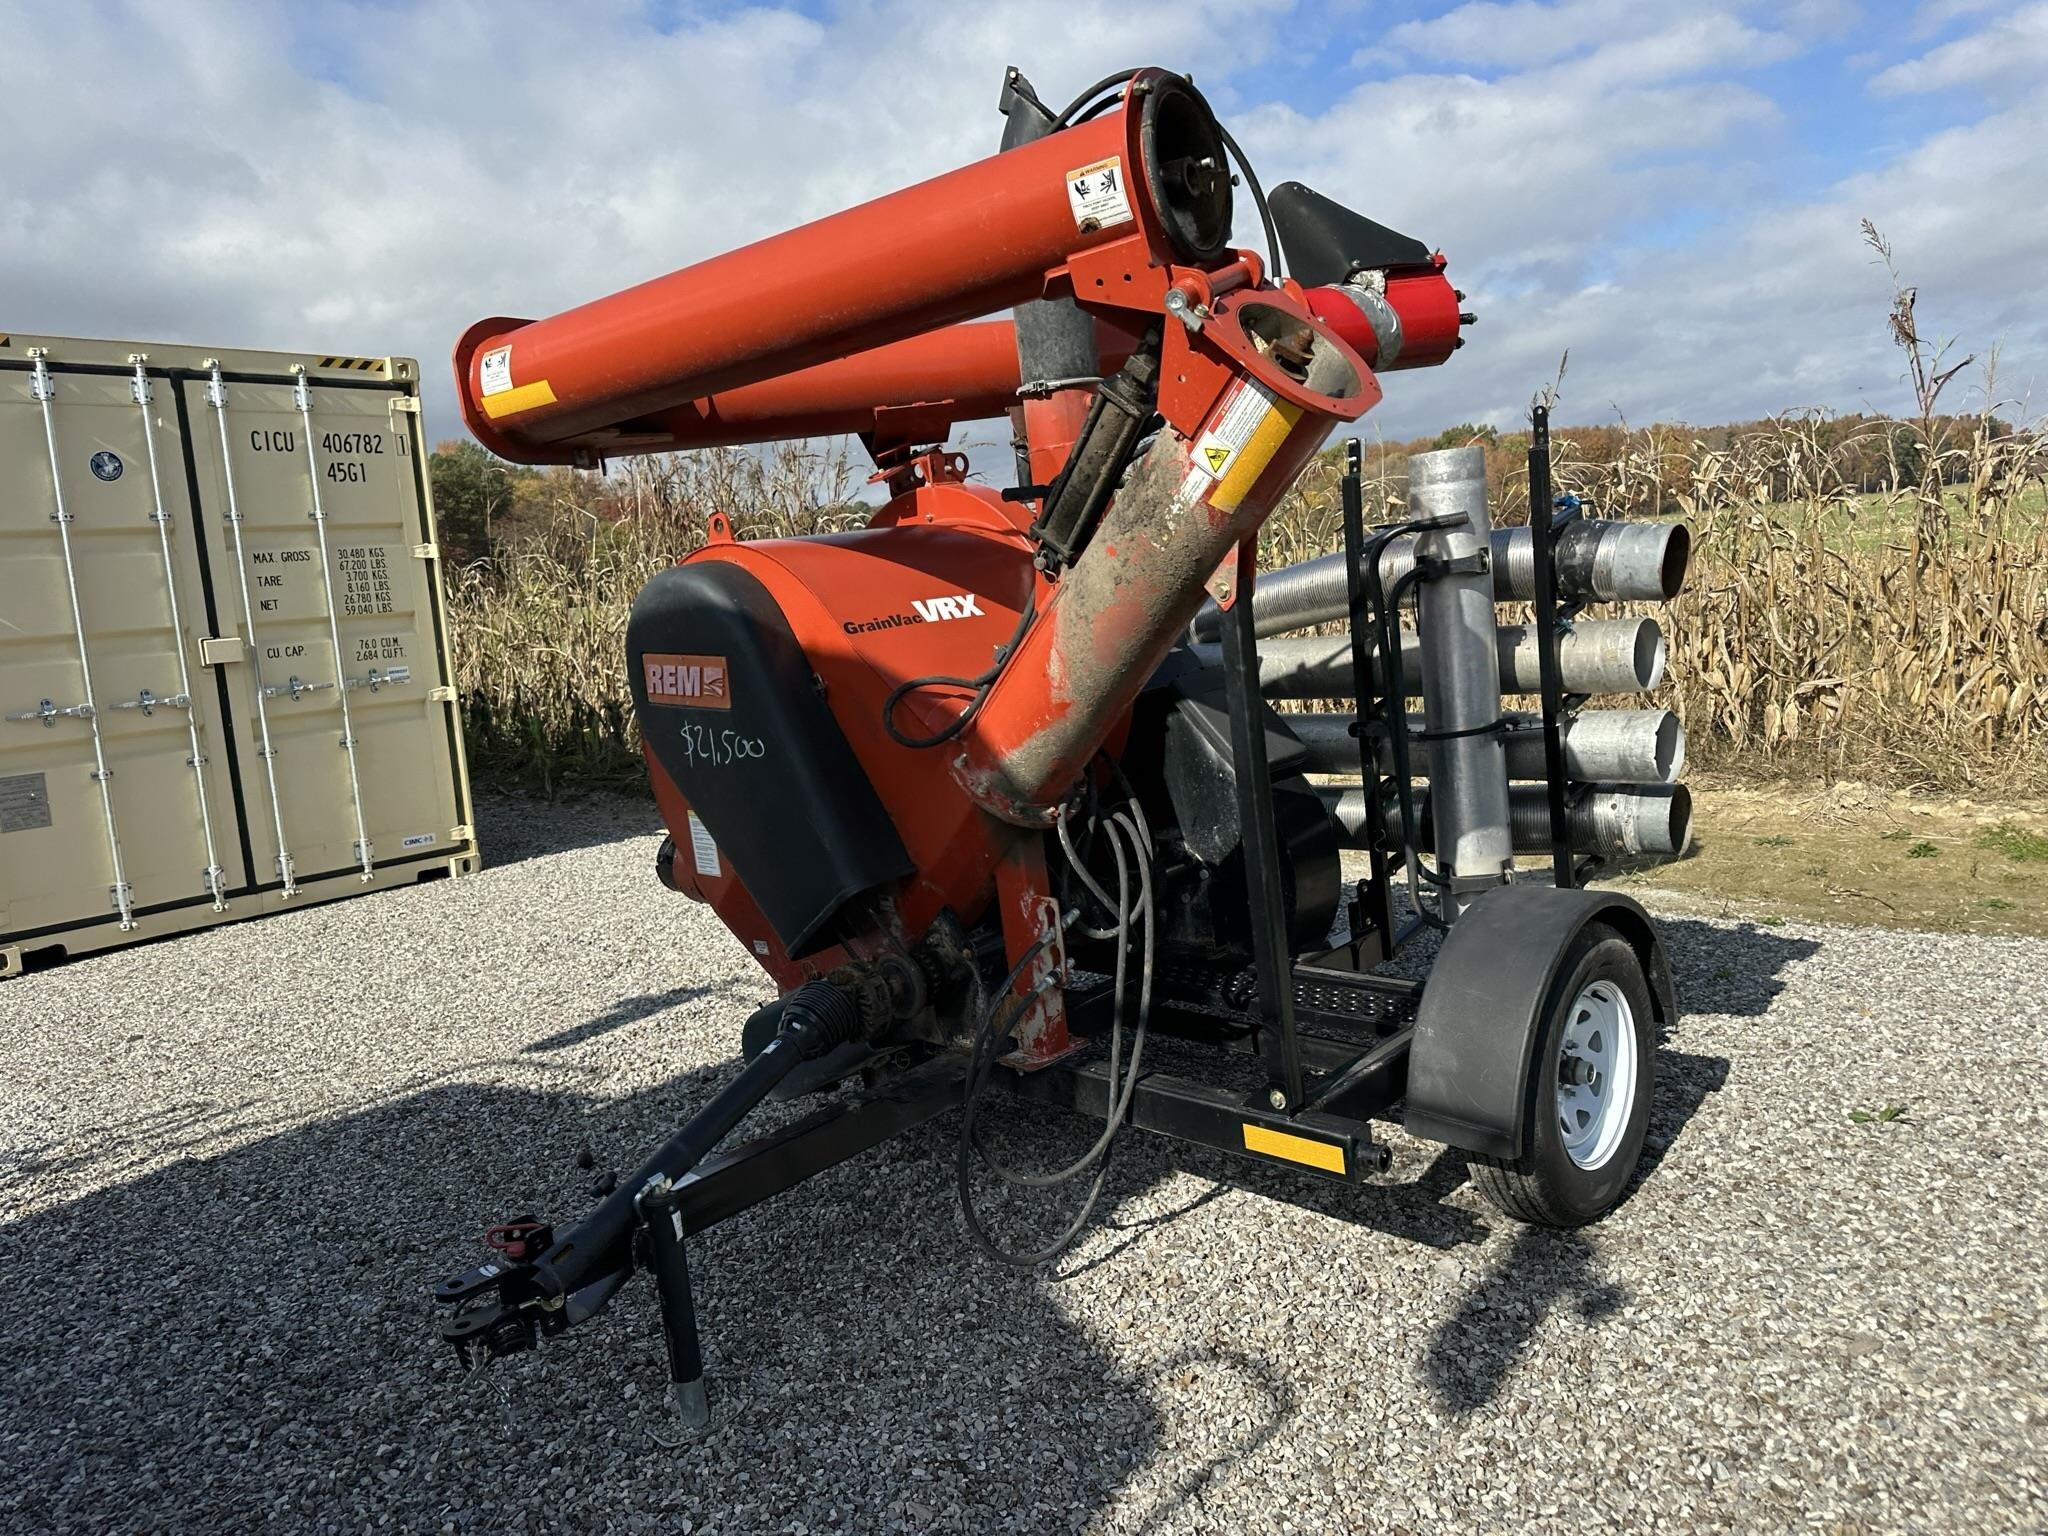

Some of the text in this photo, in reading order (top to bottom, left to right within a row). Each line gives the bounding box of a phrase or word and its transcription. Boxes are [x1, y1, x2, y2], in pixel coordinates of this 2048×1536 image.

[251, 430, 295, 452] CICU
[322, 433, 384, 454] 406782
[327, 462, 367, 483] 45G1
[253, 552, 277, 564] MAX.
[281, 550, 311, 563] GROSS
[338, 549, 365, 560] 30.480
[339, 558, 388, 571] 67.200 LBS.
[256, 569, 390, 587] TARE 3.700 KGS.
[347, 581, 391, 593] 8.160 LBS.
[260, 599, 279, 611] NET
[344, 593, 372, 605] 26.780
[345, 605, 373, 616] 59.040
[843, 593, 986, 635] GrainVac VRX
[267, 647, 282, 659] CU.
[285, 645, 308, 657] CAP.
[359, 639, 377, 650] 76.0
[356, 647, 407, 662] 2.684 CU.FT.
[646, 663, 701, 697] REM
[681, 720, 765, 768] $21,500
